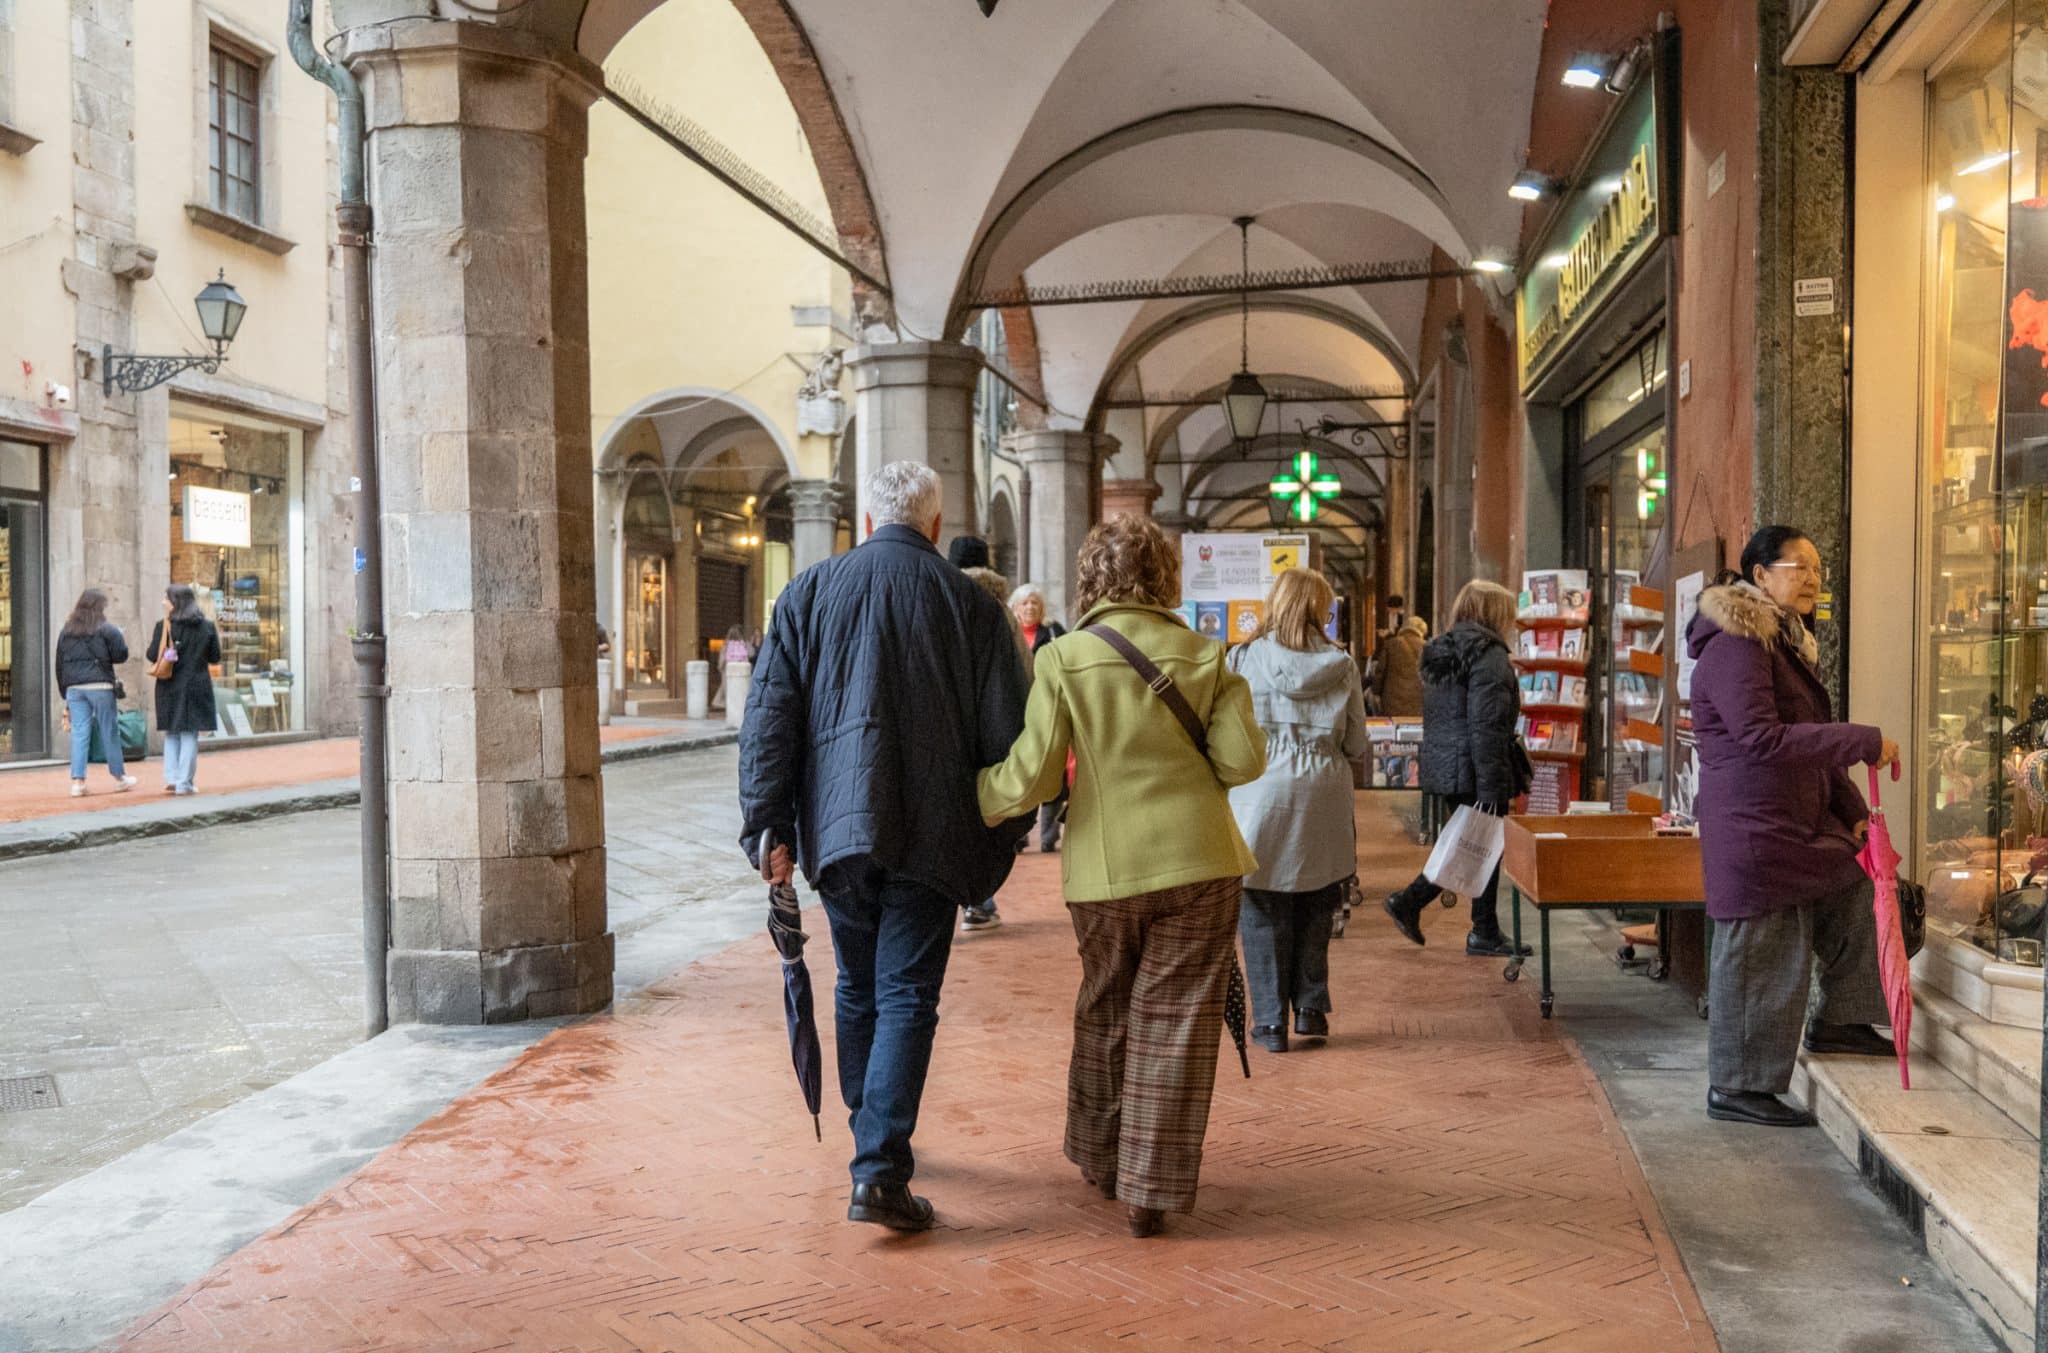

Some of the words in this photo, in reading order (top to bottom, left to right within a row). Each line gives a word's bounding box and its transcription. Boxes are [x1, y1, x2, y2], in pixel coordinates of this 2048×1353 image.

[194, 494, 247, 523] bassetti
[1221, 567, 1230, 576] LE
[1232, 567, 1260, 576] NOSTRE
[1221, 576, 1260, 585] PROPOSTE
